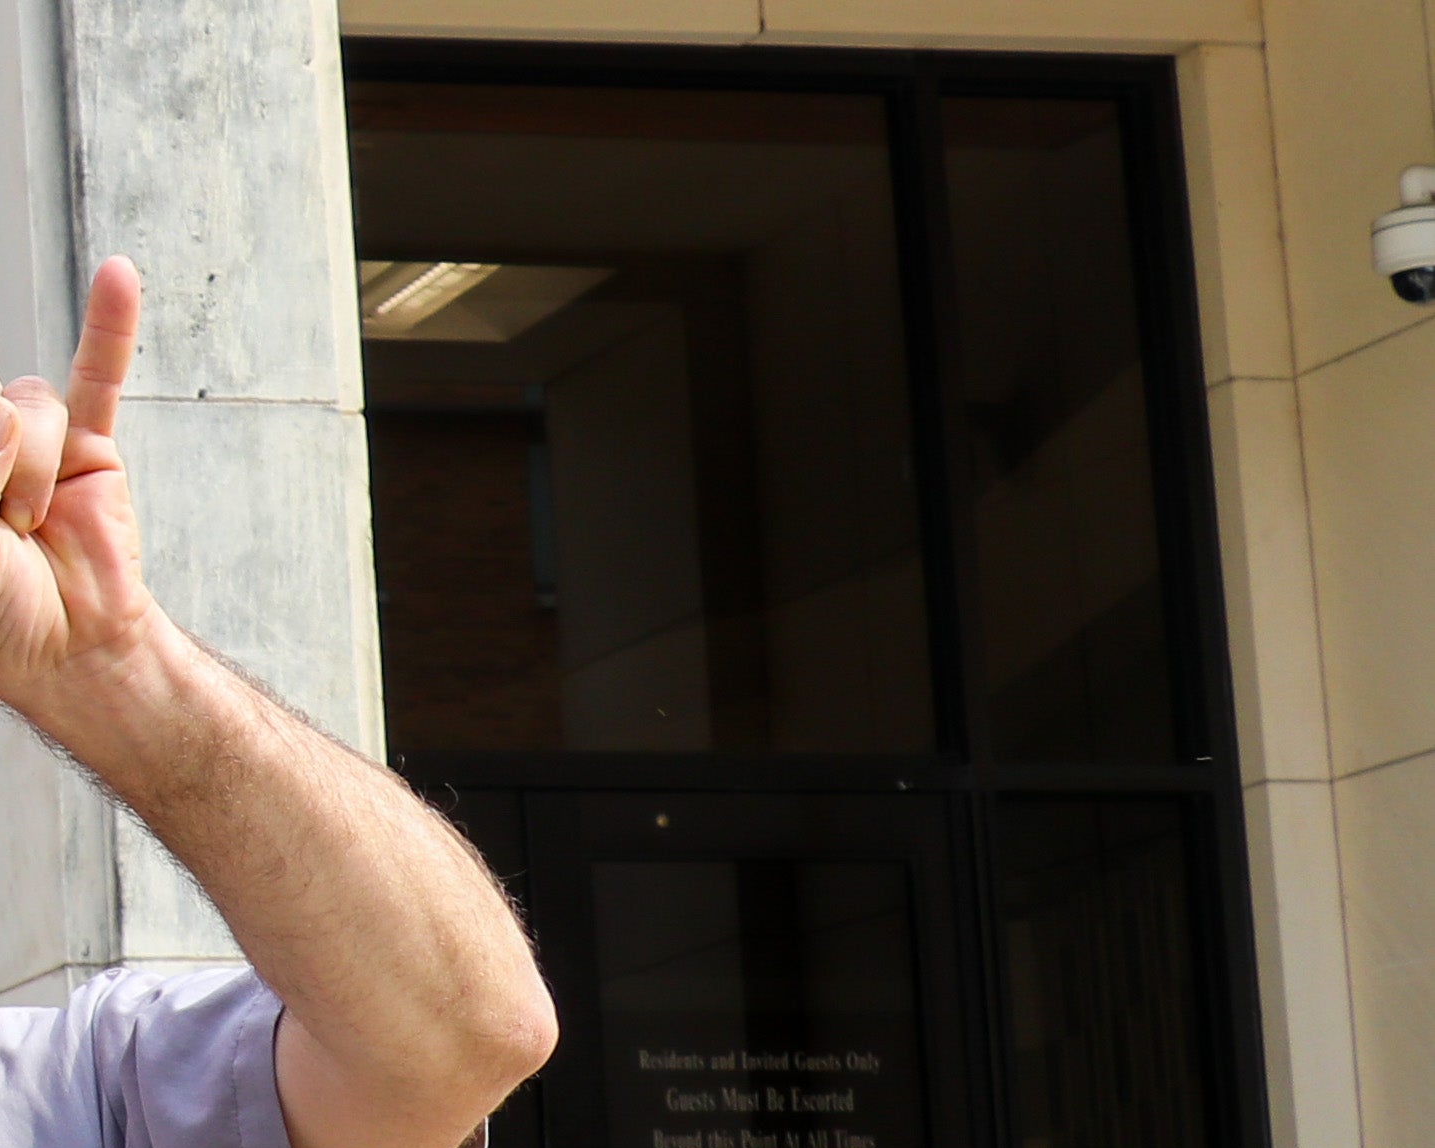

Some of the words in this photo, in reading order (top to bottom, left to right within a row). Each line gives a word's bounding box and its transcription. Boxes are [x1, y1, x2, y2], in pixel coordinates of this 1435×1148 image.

[638, 1050, 705, 1071] Residents
[711, 1050, 735, 1071] and
[741, 1050, 789, 1071] Invited
[794, 1050, 841, 1071] Guests
[846, 1050, 882, 1075] Only
[665, 1086, 716, 1112] Guests
[721, 1086, 759, 1112] Must
[767, 1086, 785, 1112] Be
[790, 1086, 854, 1112] Escorted
